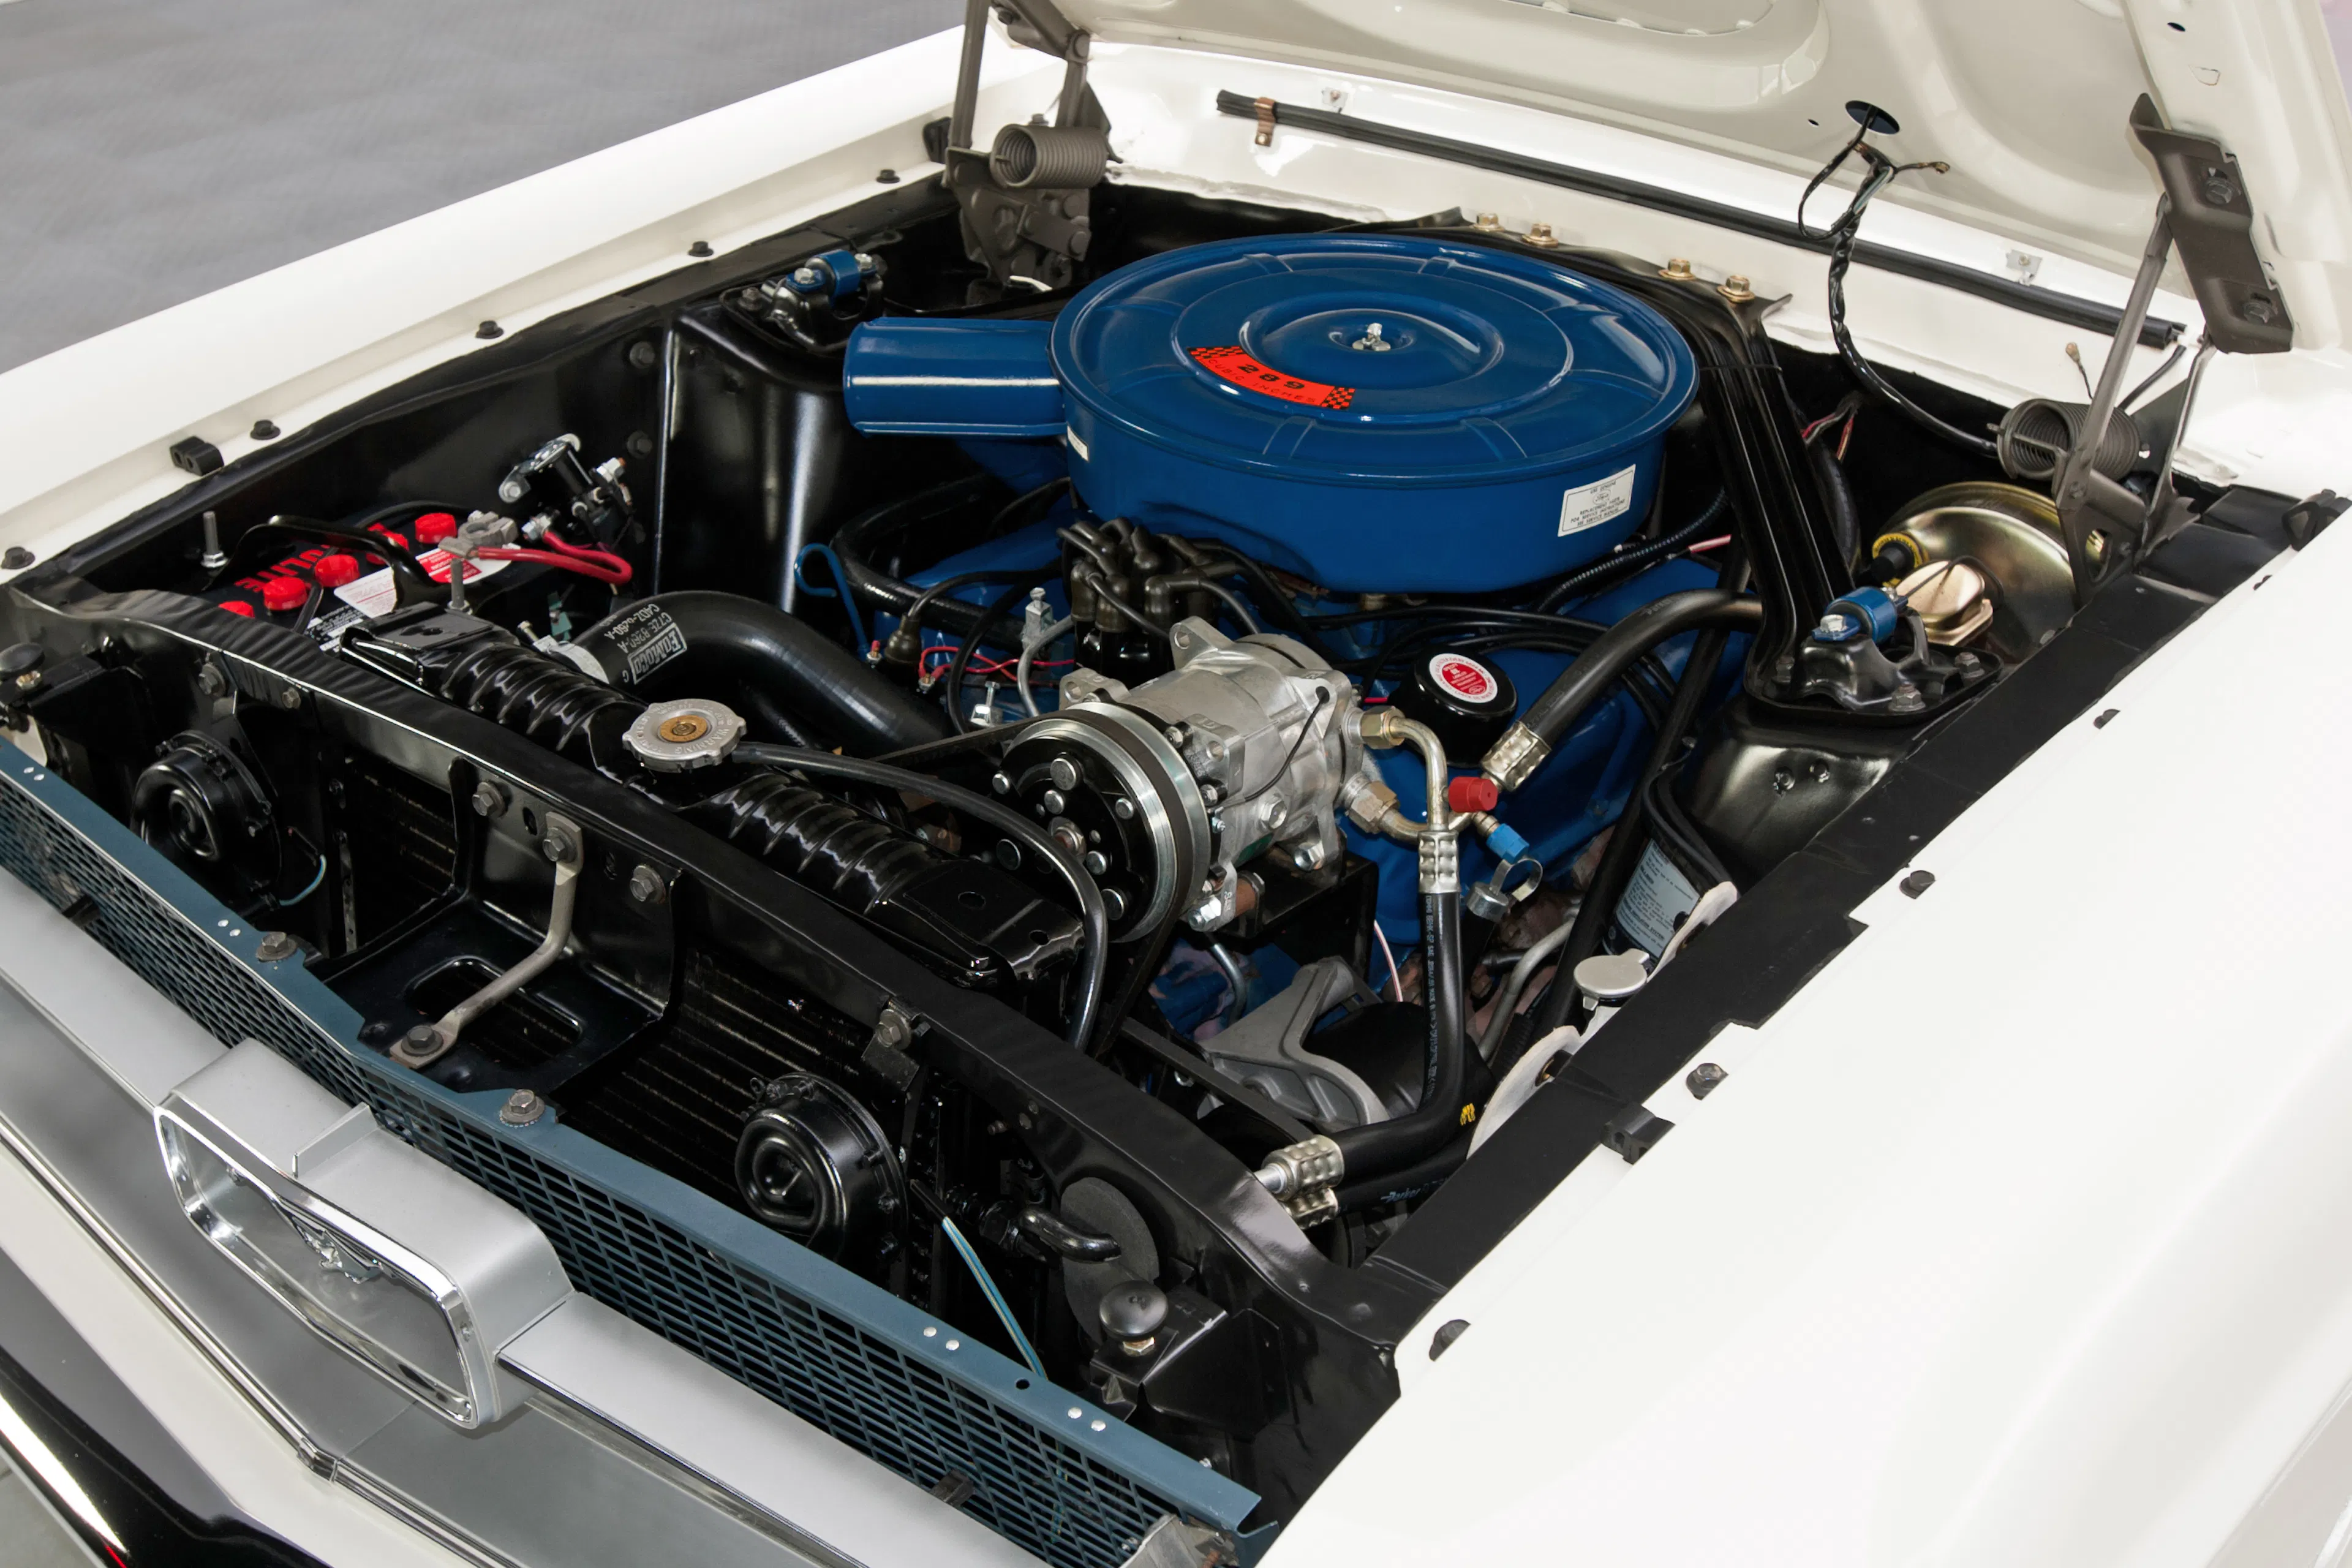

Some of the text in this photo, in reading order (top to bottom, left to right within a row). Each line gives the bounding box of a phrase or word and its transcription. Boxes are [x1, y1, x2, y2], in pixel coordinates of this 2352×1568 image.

[1208, 359, 1316, 402] CUBIC INCHES
[1238, 364, 1305, 390] 289
[674, 728, 729, 754] WARNING
[1380, 1187, 1422, 1204] Parker
